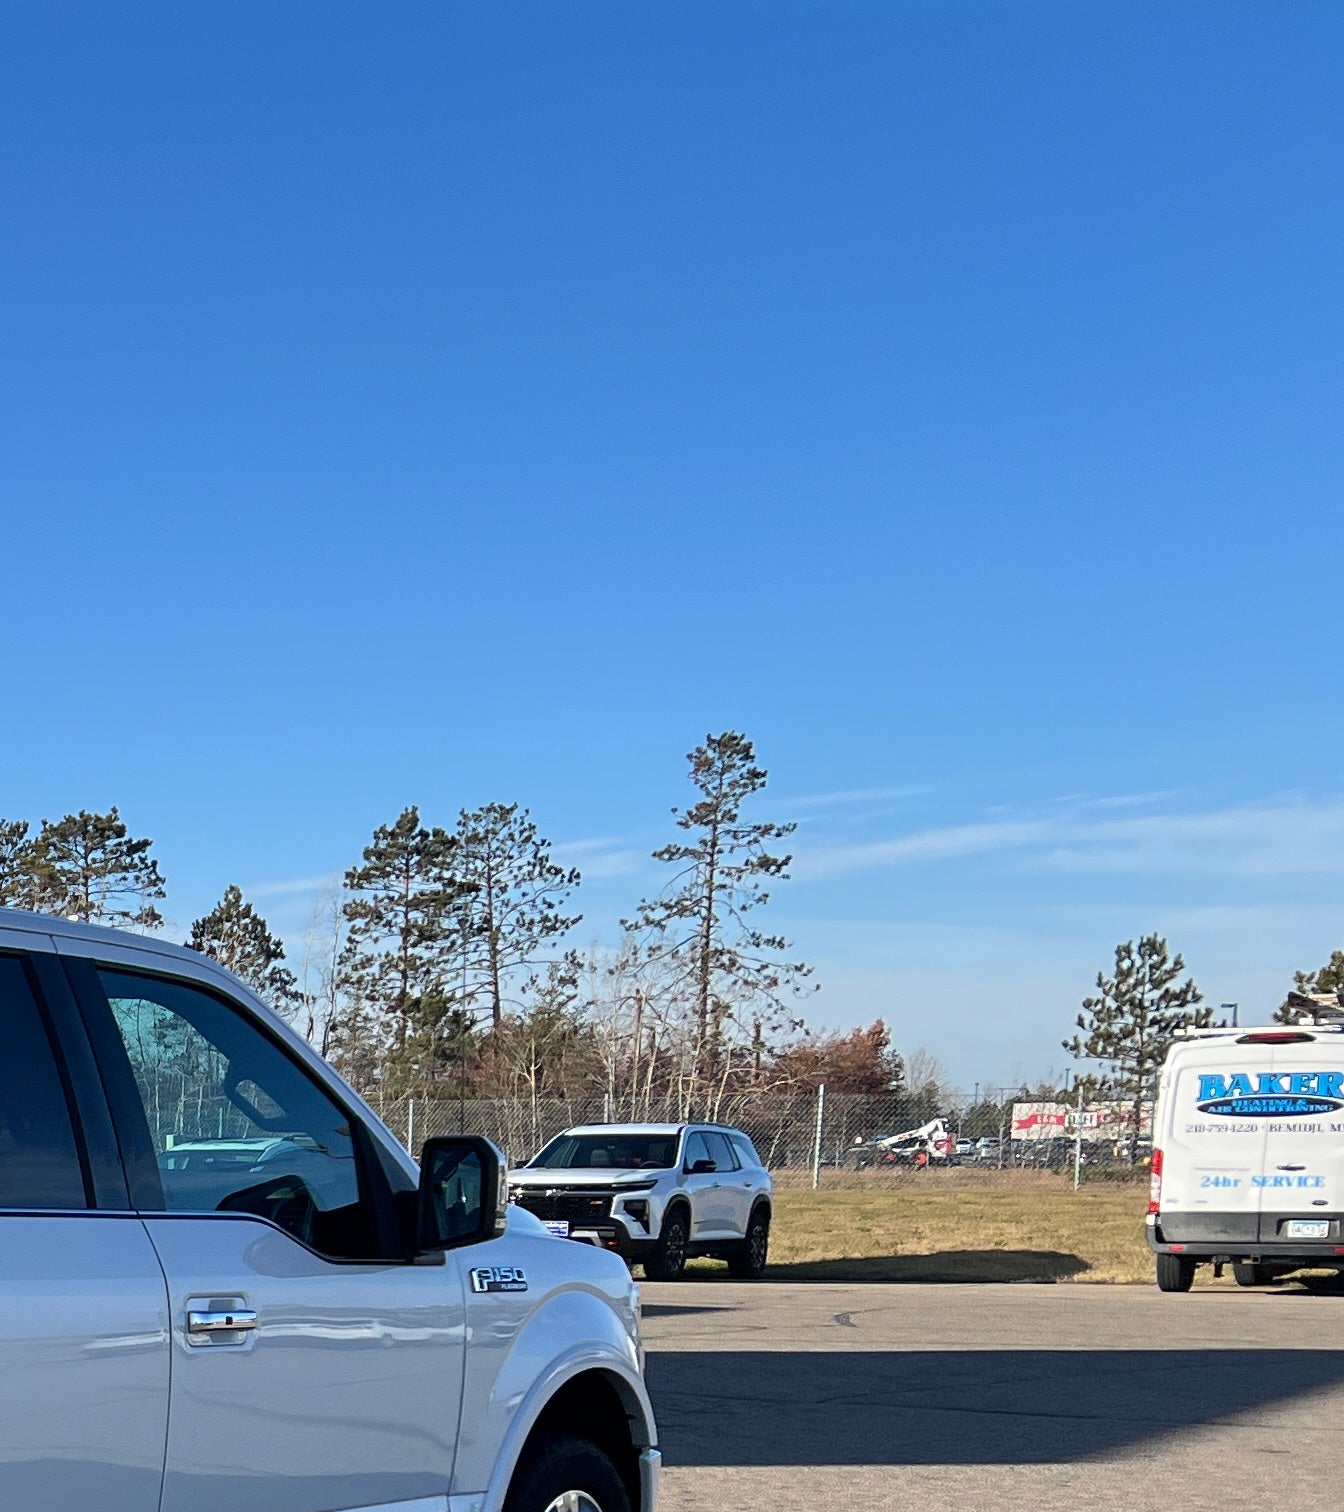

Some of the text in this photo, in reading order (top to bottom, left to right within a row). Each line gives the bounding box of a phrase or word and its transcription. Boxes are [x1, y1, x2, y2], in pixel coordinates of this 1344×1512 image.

[1196, 1071, 1344, 1102] BAKER
[1201, 1175, 1325, 1188] 24hr SERVICE
